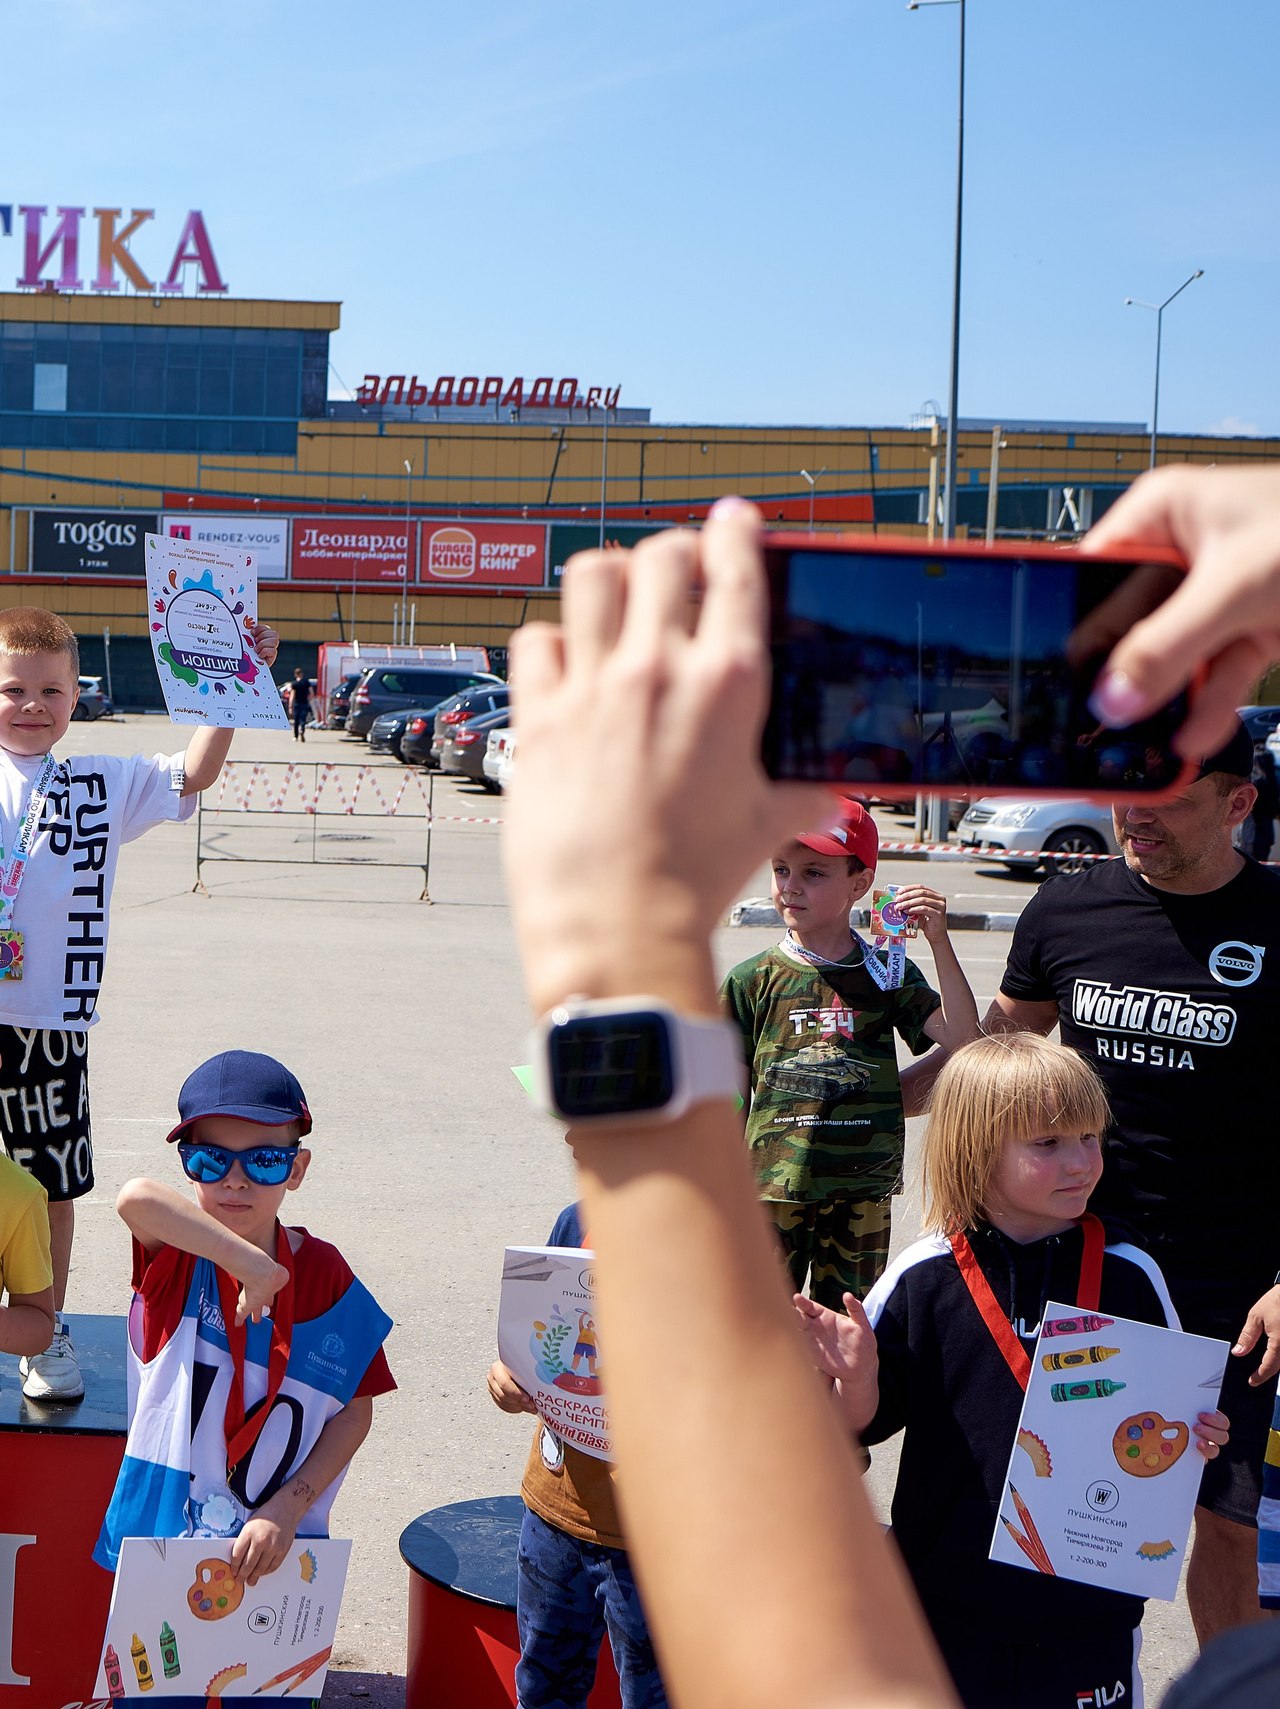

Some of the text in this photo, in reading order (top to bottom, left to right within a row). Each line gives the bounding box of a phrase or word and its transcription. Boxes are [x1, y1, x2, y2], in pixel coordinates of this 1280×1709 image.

[198, 532, 280, 544] RENDEZ-VOUS
[300, 529, 408, 551] Леонардо
[300, 548, 408, 561] хобби-гипермаркет
[432, 543, 473, 554] BURGER
[480, 543, 536, 558] БУРГЕР
[431, 554, 472, 567] KING
[480, 557, 520, 570] КИНГ
[182, 652, 240, 672] ДИПЛОМ
[30, 800, 40, 814] ПО
[18, 813, 36, 854] РОЛИКАМ
[63, 772, 109, 1022] FURTHER
[1216, 956, 1256, 970] VOLVO
[789, 1012, 854, 1035] Т-34
[1076, 985, 1231, 1042] World Class
[1096, 1036, 1196, 1071] RUSSIA
[308, 1350, 348, 1376] Пушкинский
[536, 1390, 611, 1418] РАСКРАСК
[543, 1414, 611, 1451] World Class
[1068, 1508, 1128, 1528] ПУШКИНСКИЙ
[1064, 1528, 1123, 1548] Нижний Новгород
[1066, 1536, 1118, 1554] Тимирязева 31А
[1076, 1556, 1108, 1568] 2-200-300
[274, 1594, 290, 1646] ПУШКИНСКИЙ
[1076, 1680, 1126, 1709] FILA
